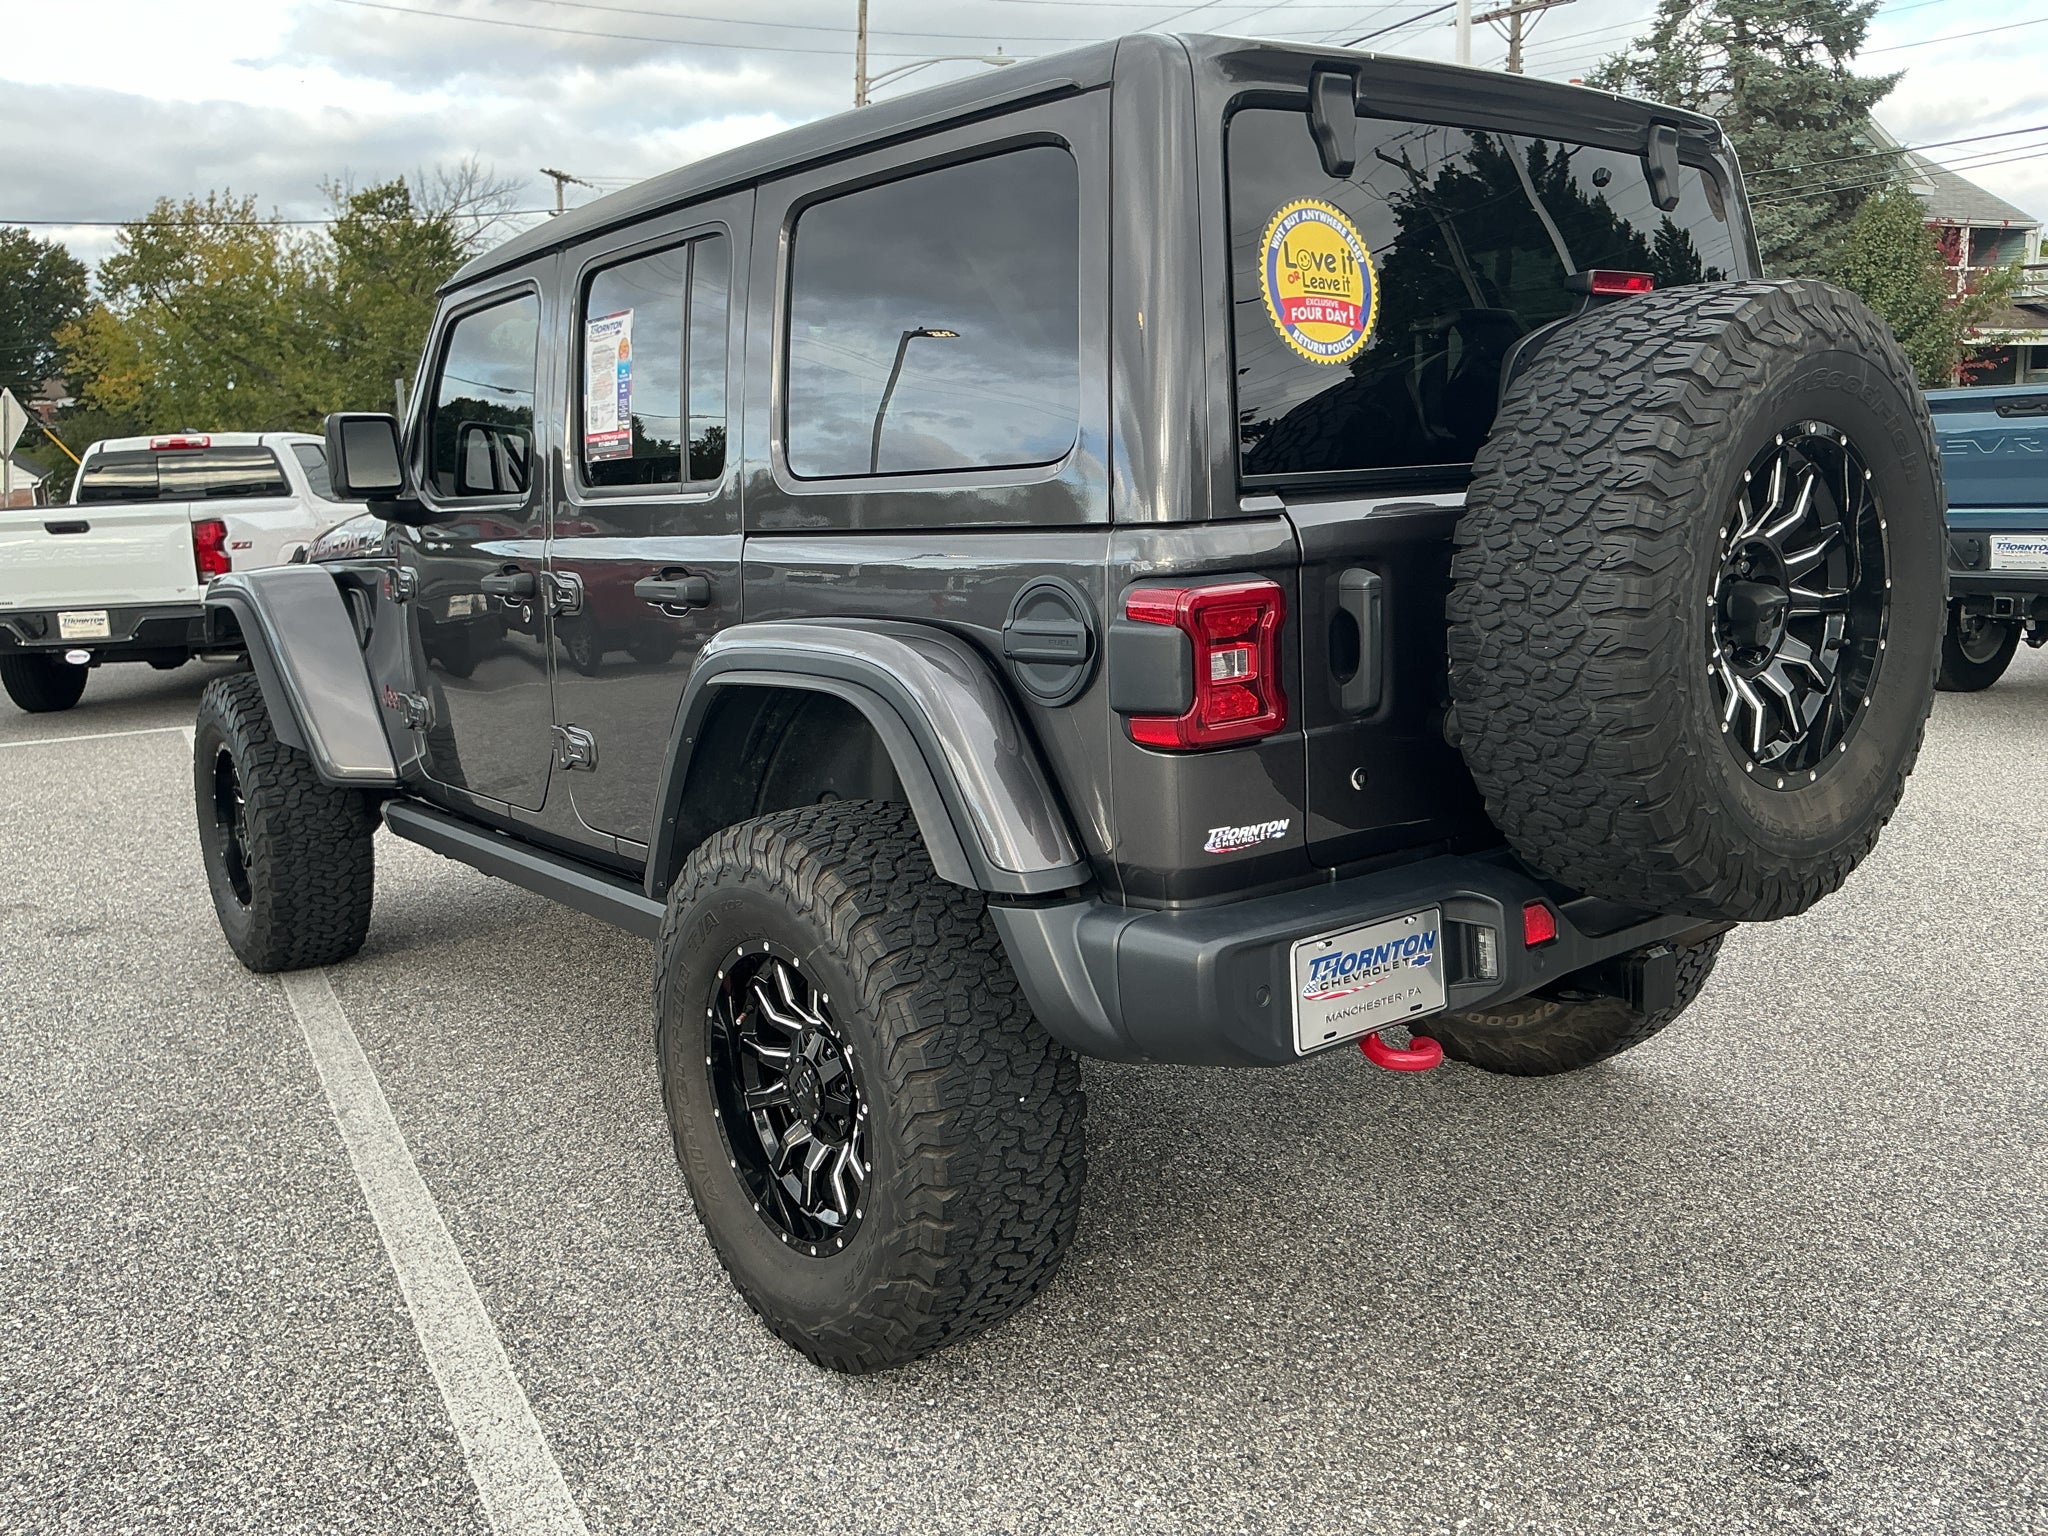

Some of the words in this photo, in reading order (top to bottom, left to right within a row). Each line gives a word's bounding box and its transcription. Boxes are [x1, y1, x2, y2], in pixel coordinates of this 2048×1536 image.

[1271, 228, 1286, 249] WHY
[1283, 211, 1300, 230] BUY
[1302, 210, 1347, 236] ANYWHERE
[1346, 234, 1365, 262] ELSE?
[1283, 241, 1337, 273] Love
[1341, 248, 1354, 275] it
[1288, 271, 1301, 284] OR
[1302, 272, 1340, 291] Leave
[1342, 276, 1351, 292] it
[1291, 307, 1323, 320] FOUR
[1306, 298, 1339, 308] EXCLUSIVE
[1293, 329, 1326, 354] RETURN
[1328, 334, 1355, 354] POLICY
[1996, 542, 2048, 551] THORNTO
[1208, 819, 1289, 842] THORNTON
[1215, 832, 1271, 848] CHEVROLET
[1309, 930, 1436, 982] THORNTON
[1320, 957, 1410, 991] CHEVROLET
[1325, 991, 1405, 1024] MANCHESTER,
[1407, 987, 1422, 999] PA
